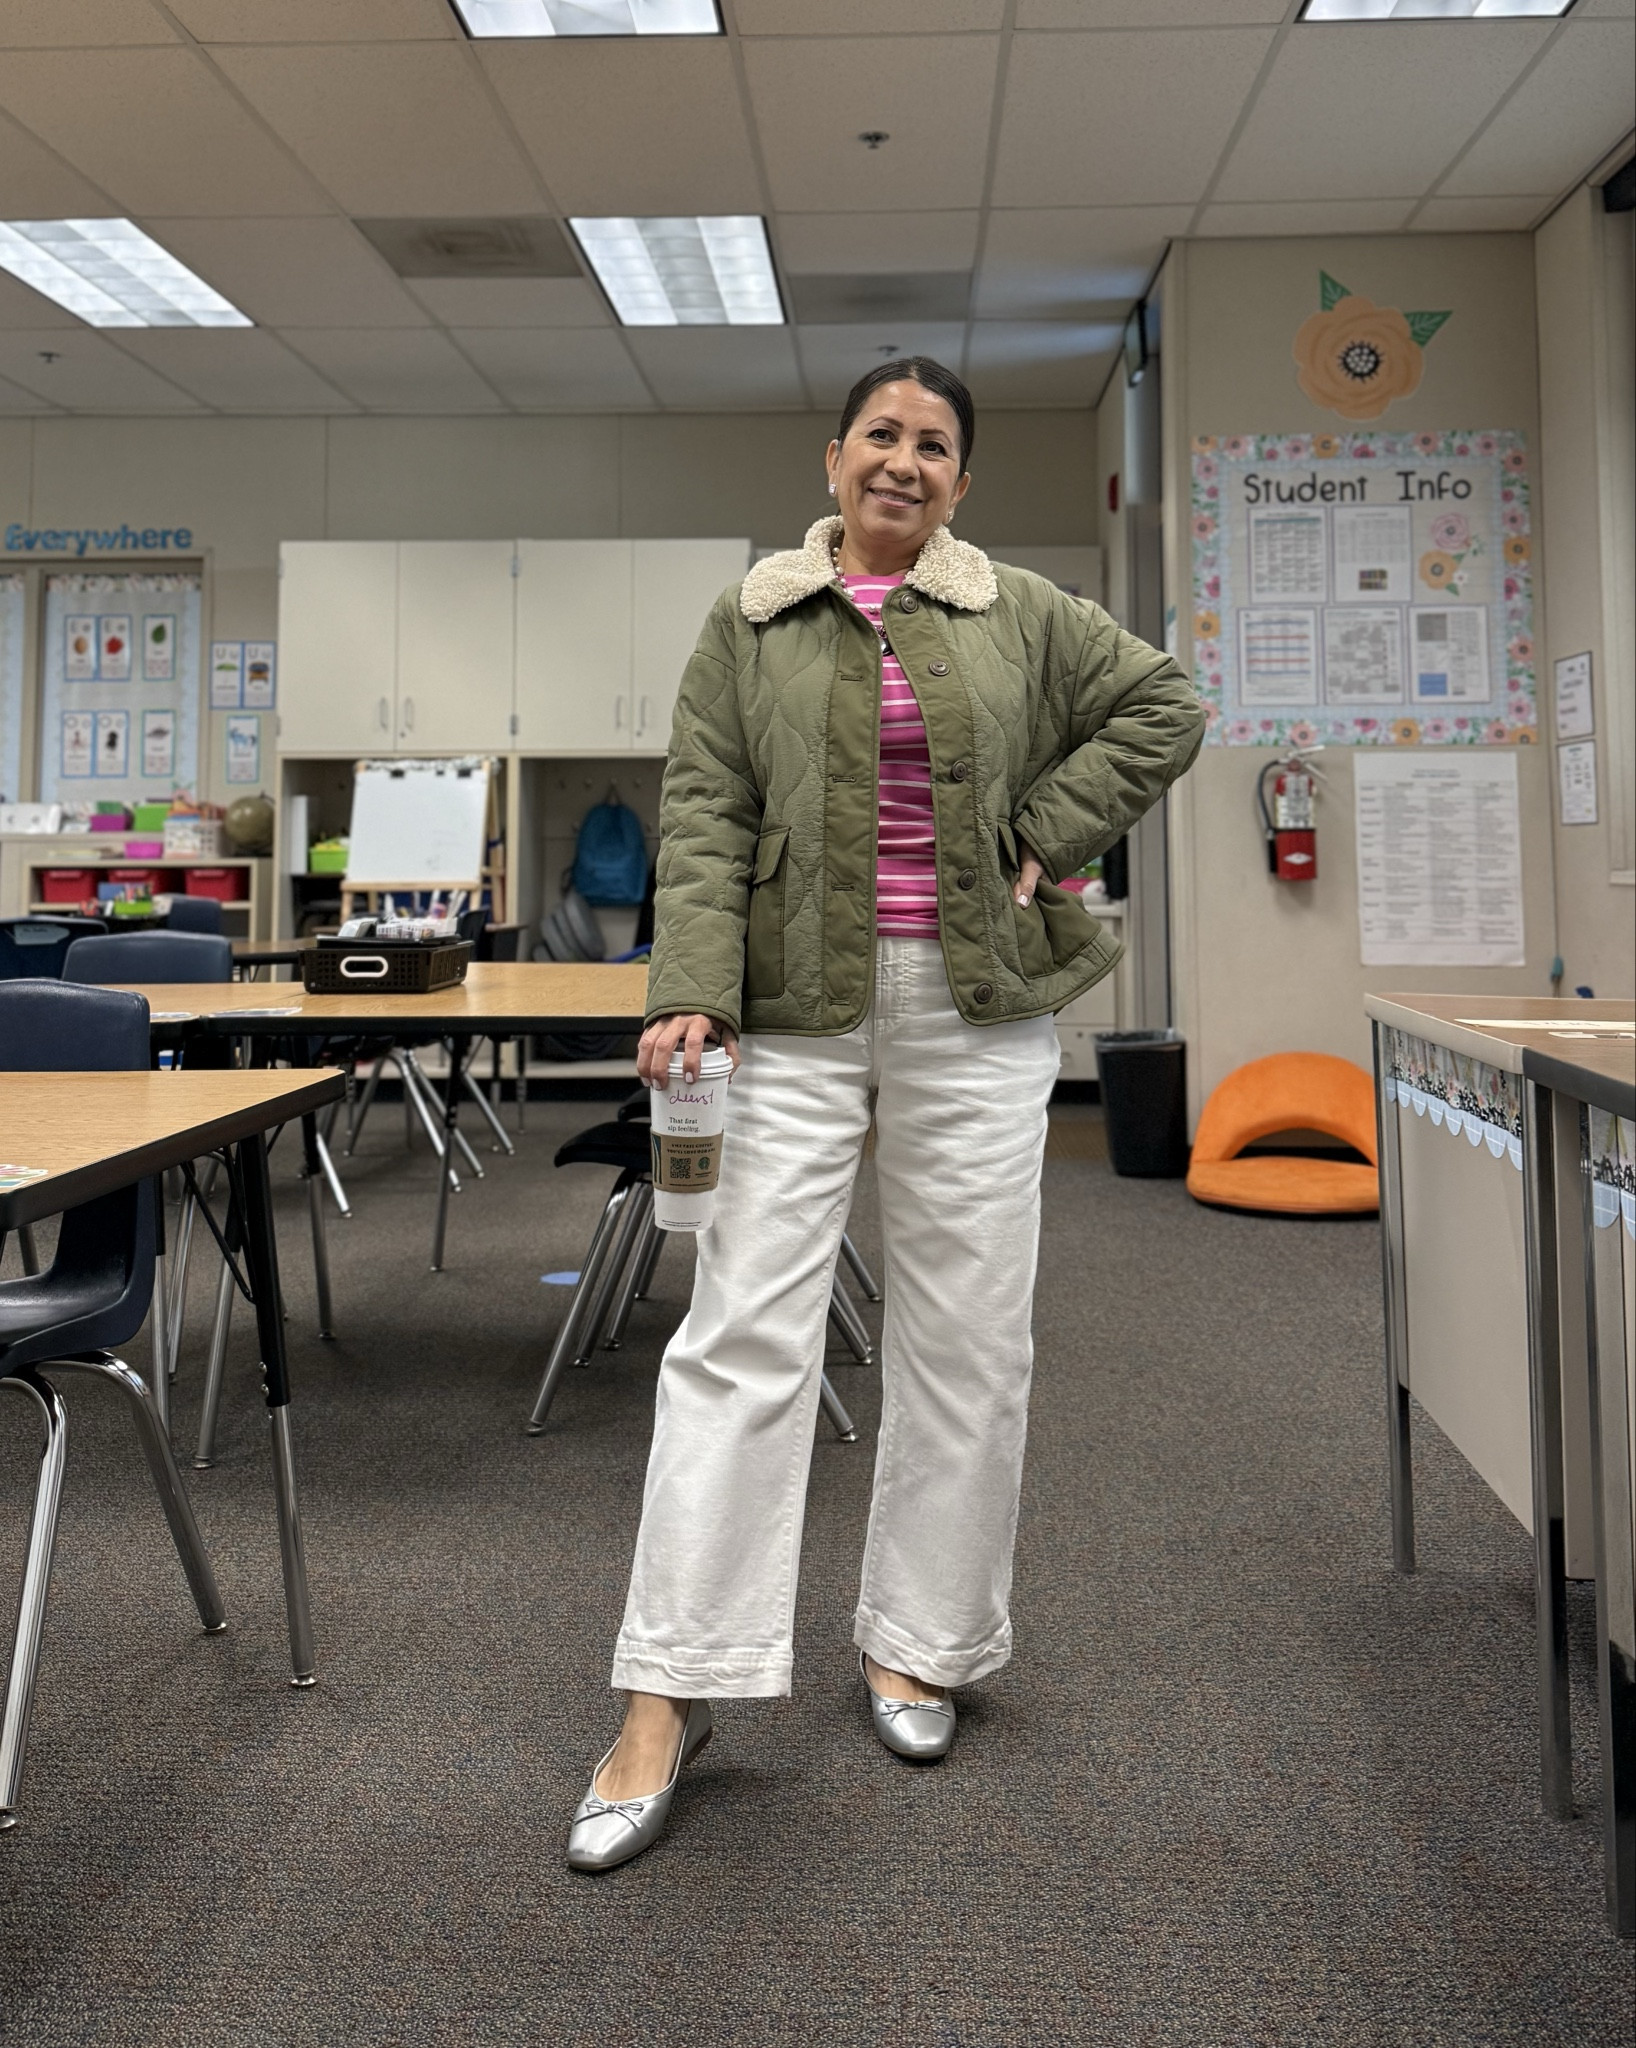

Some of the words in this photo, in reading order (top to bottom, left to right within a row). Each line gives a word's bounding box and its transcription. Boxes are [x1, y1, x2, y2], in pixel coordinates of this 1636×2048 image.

[1244, 472, 1368, 504] Student
[1396, 471, 1472, 501] Info
[5, 524, 193, 557] Everywhere
[669, 1116, 683, 1124] That
